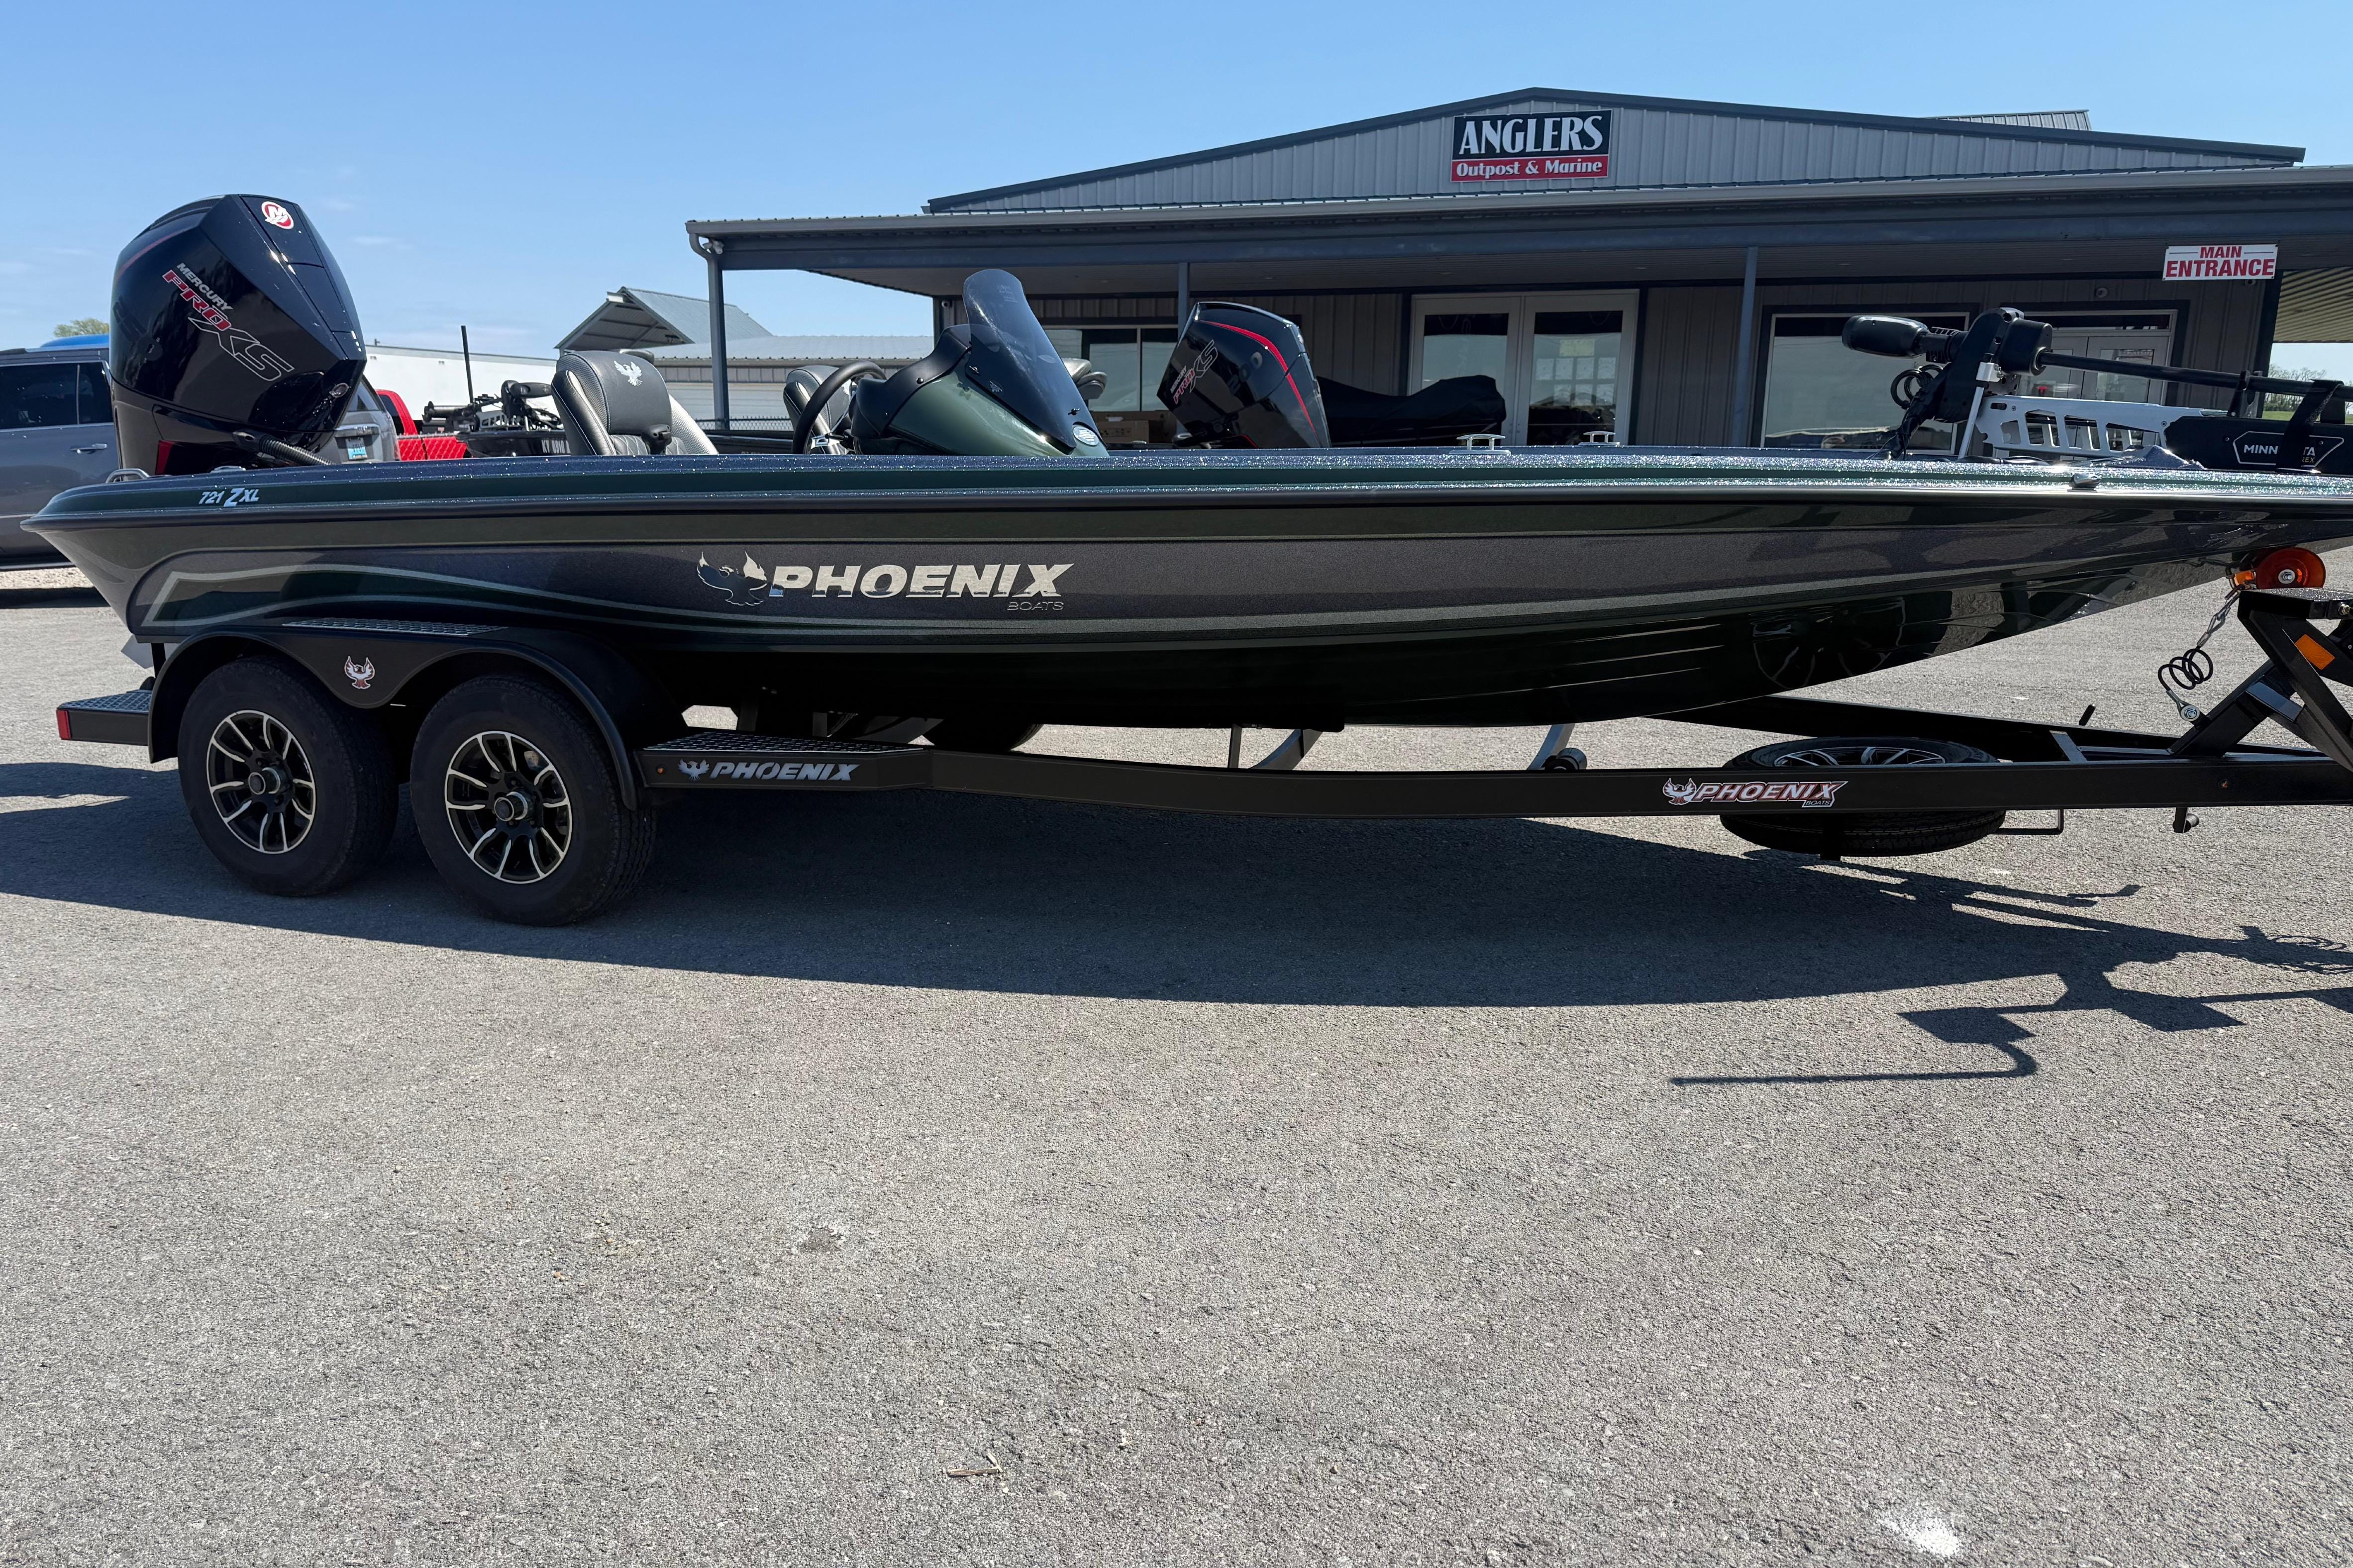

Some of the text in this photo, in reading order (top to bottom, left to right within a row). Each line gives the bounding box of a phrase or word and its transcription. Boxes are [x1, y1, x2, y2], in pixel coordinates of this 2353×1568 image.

[1458, 115, 1603, 155] ANGLERS
[1456, 158, 1602, 179] Outpost & Marine
[2199, 246, 2242, 259] MAIN
[2165, 258, 2275, 277] ENTRANCE
[176, 262, 234, 311] MERCURY
[162, 269, 295, 382] PRO XS
[1170, 365, 1187, 394] MERCURY
[1173, 339, 1218, 405] PRO XS
[2243, 444, 2278, 455] MINN
[199, 488, 259, 507] 721 ZXL
[769, 563, 1075, 598] PHOENIX
[1007, 601, 1064, 610] BOATS
[709, 762, 860, 781] PHOENIX
[1692, 782, 1847, 801] PHOENIX
